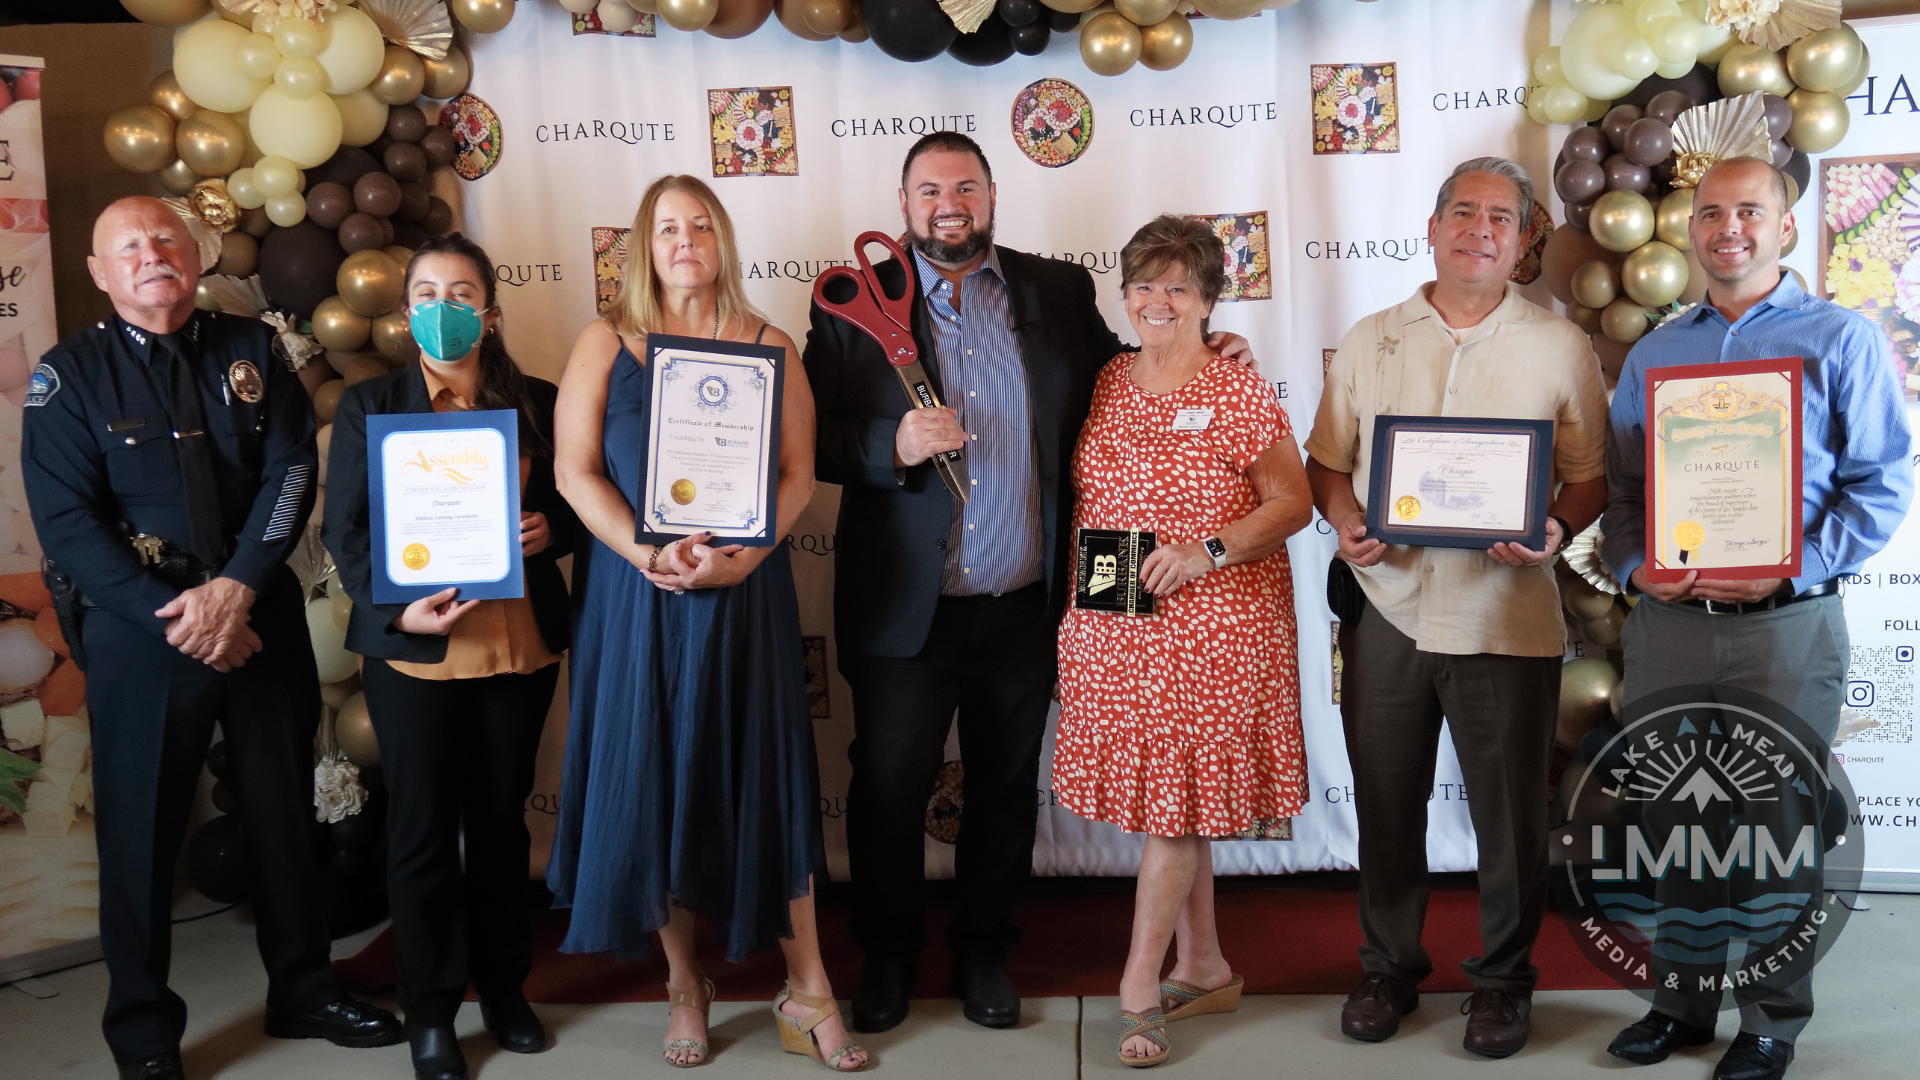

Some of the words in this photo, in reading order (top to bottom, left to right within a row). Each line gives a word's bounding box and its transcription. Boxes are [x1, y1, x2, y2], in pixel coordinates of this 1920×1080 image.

[1433, 86, 1541, 111] CHARQ
[831, 114, 977, 137] CHARQUTE
[1130, 102, 1277, 128] CHARQUTE
[536, 120, 675, 145] CHARQUTE
[668, 417, 703, 426] Certificate
[714, 422, 754, 432] Membership
[1672, 429, 1705, 441] County
[1706, 424, 1714, 435] of
[1717, 423, 1735, 434] Los
[1736, 422, 1772, 437] Angeles
[670, 435, 705, 443] CHARQUTE
[400, 446, 489, 475] Assembly
[1684, 460, 1760, 472] CHARQUTE
[1130, 531, 1138, 568] COMMERCE
[1116, 536, 1129, 607] BURBANK
[1128, 580, 1136, 613] CHAMBER
[1858, 796, 1901, 806] PLACE
